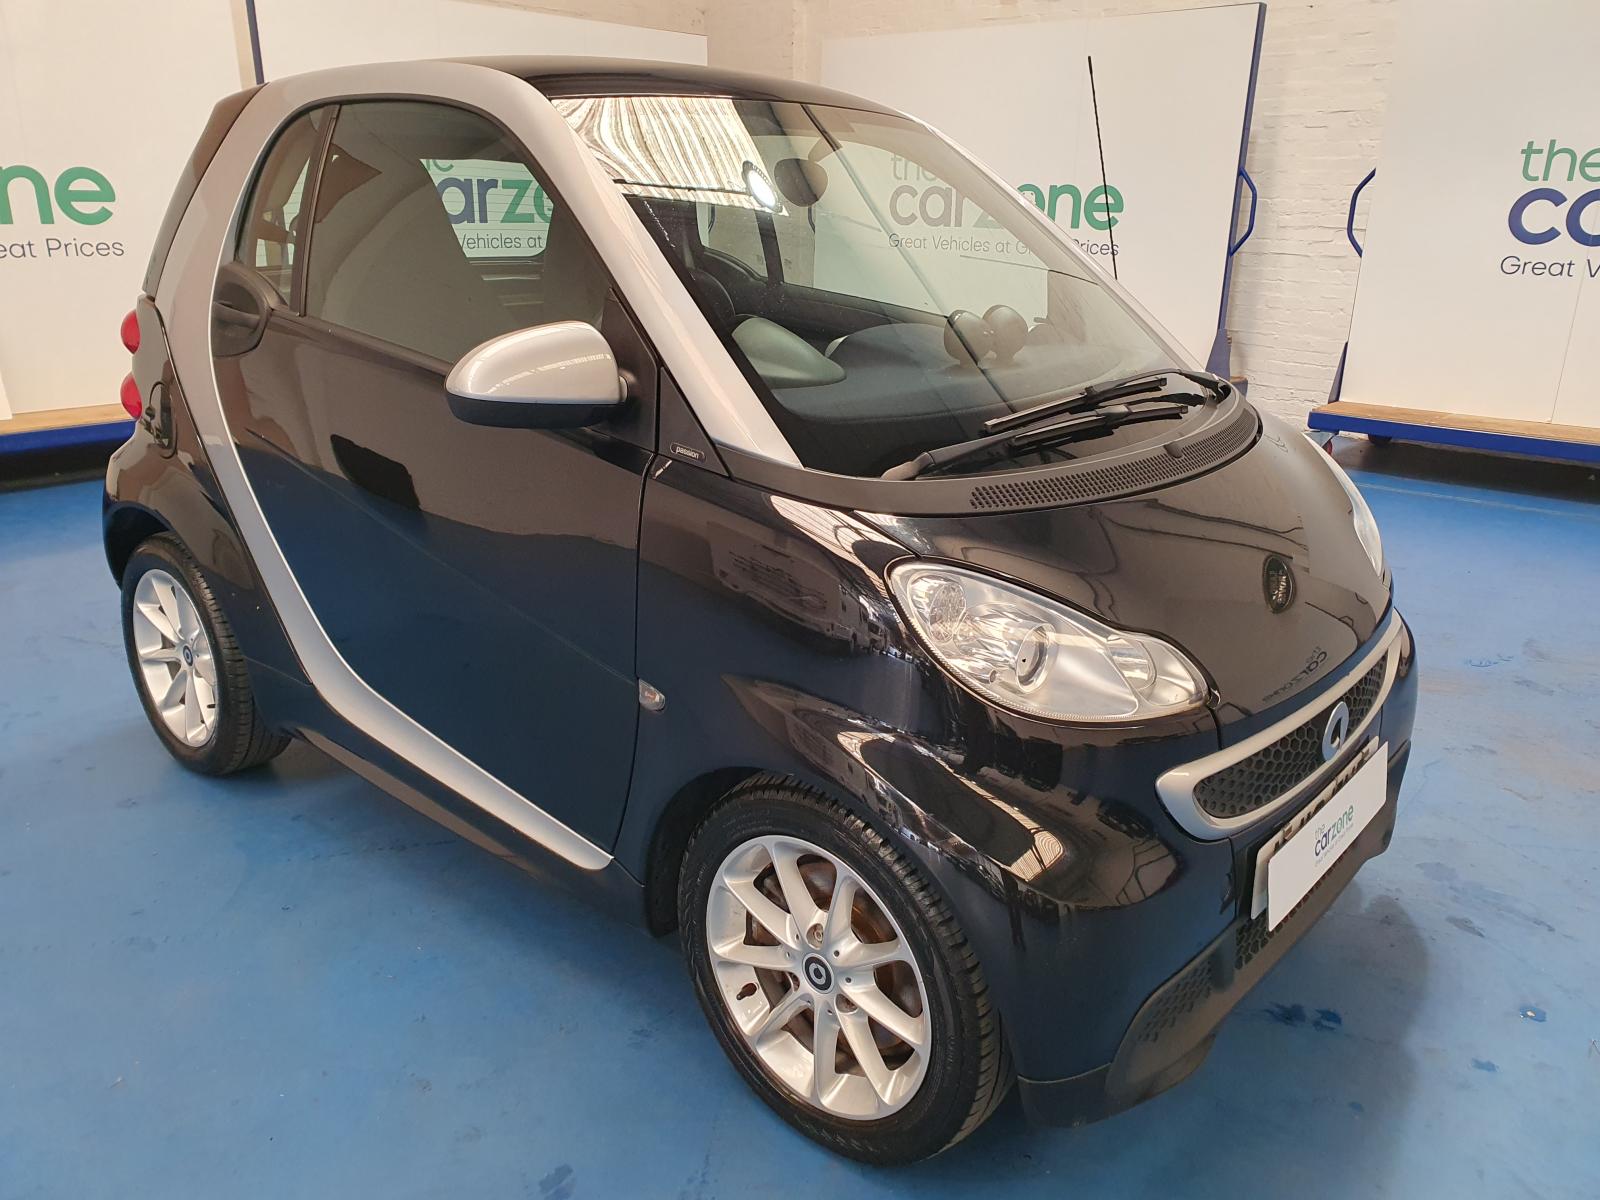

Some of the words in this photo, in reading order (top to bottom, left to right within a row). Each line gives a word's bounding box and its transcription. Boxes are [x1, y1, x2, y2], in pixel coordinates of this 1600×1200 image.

[46, 238, 124, 257] Prices
[527, 235, 544, 249] at
[889, 233, 927, 249] Great
[932, 235, 990, 252] Vehicles
[995, 240, 1010, 253] at
[1500, 256, 1575, 277] Great
[675, 446, 699, 459] passion
[1314, 805, 1354, 857] carzone
